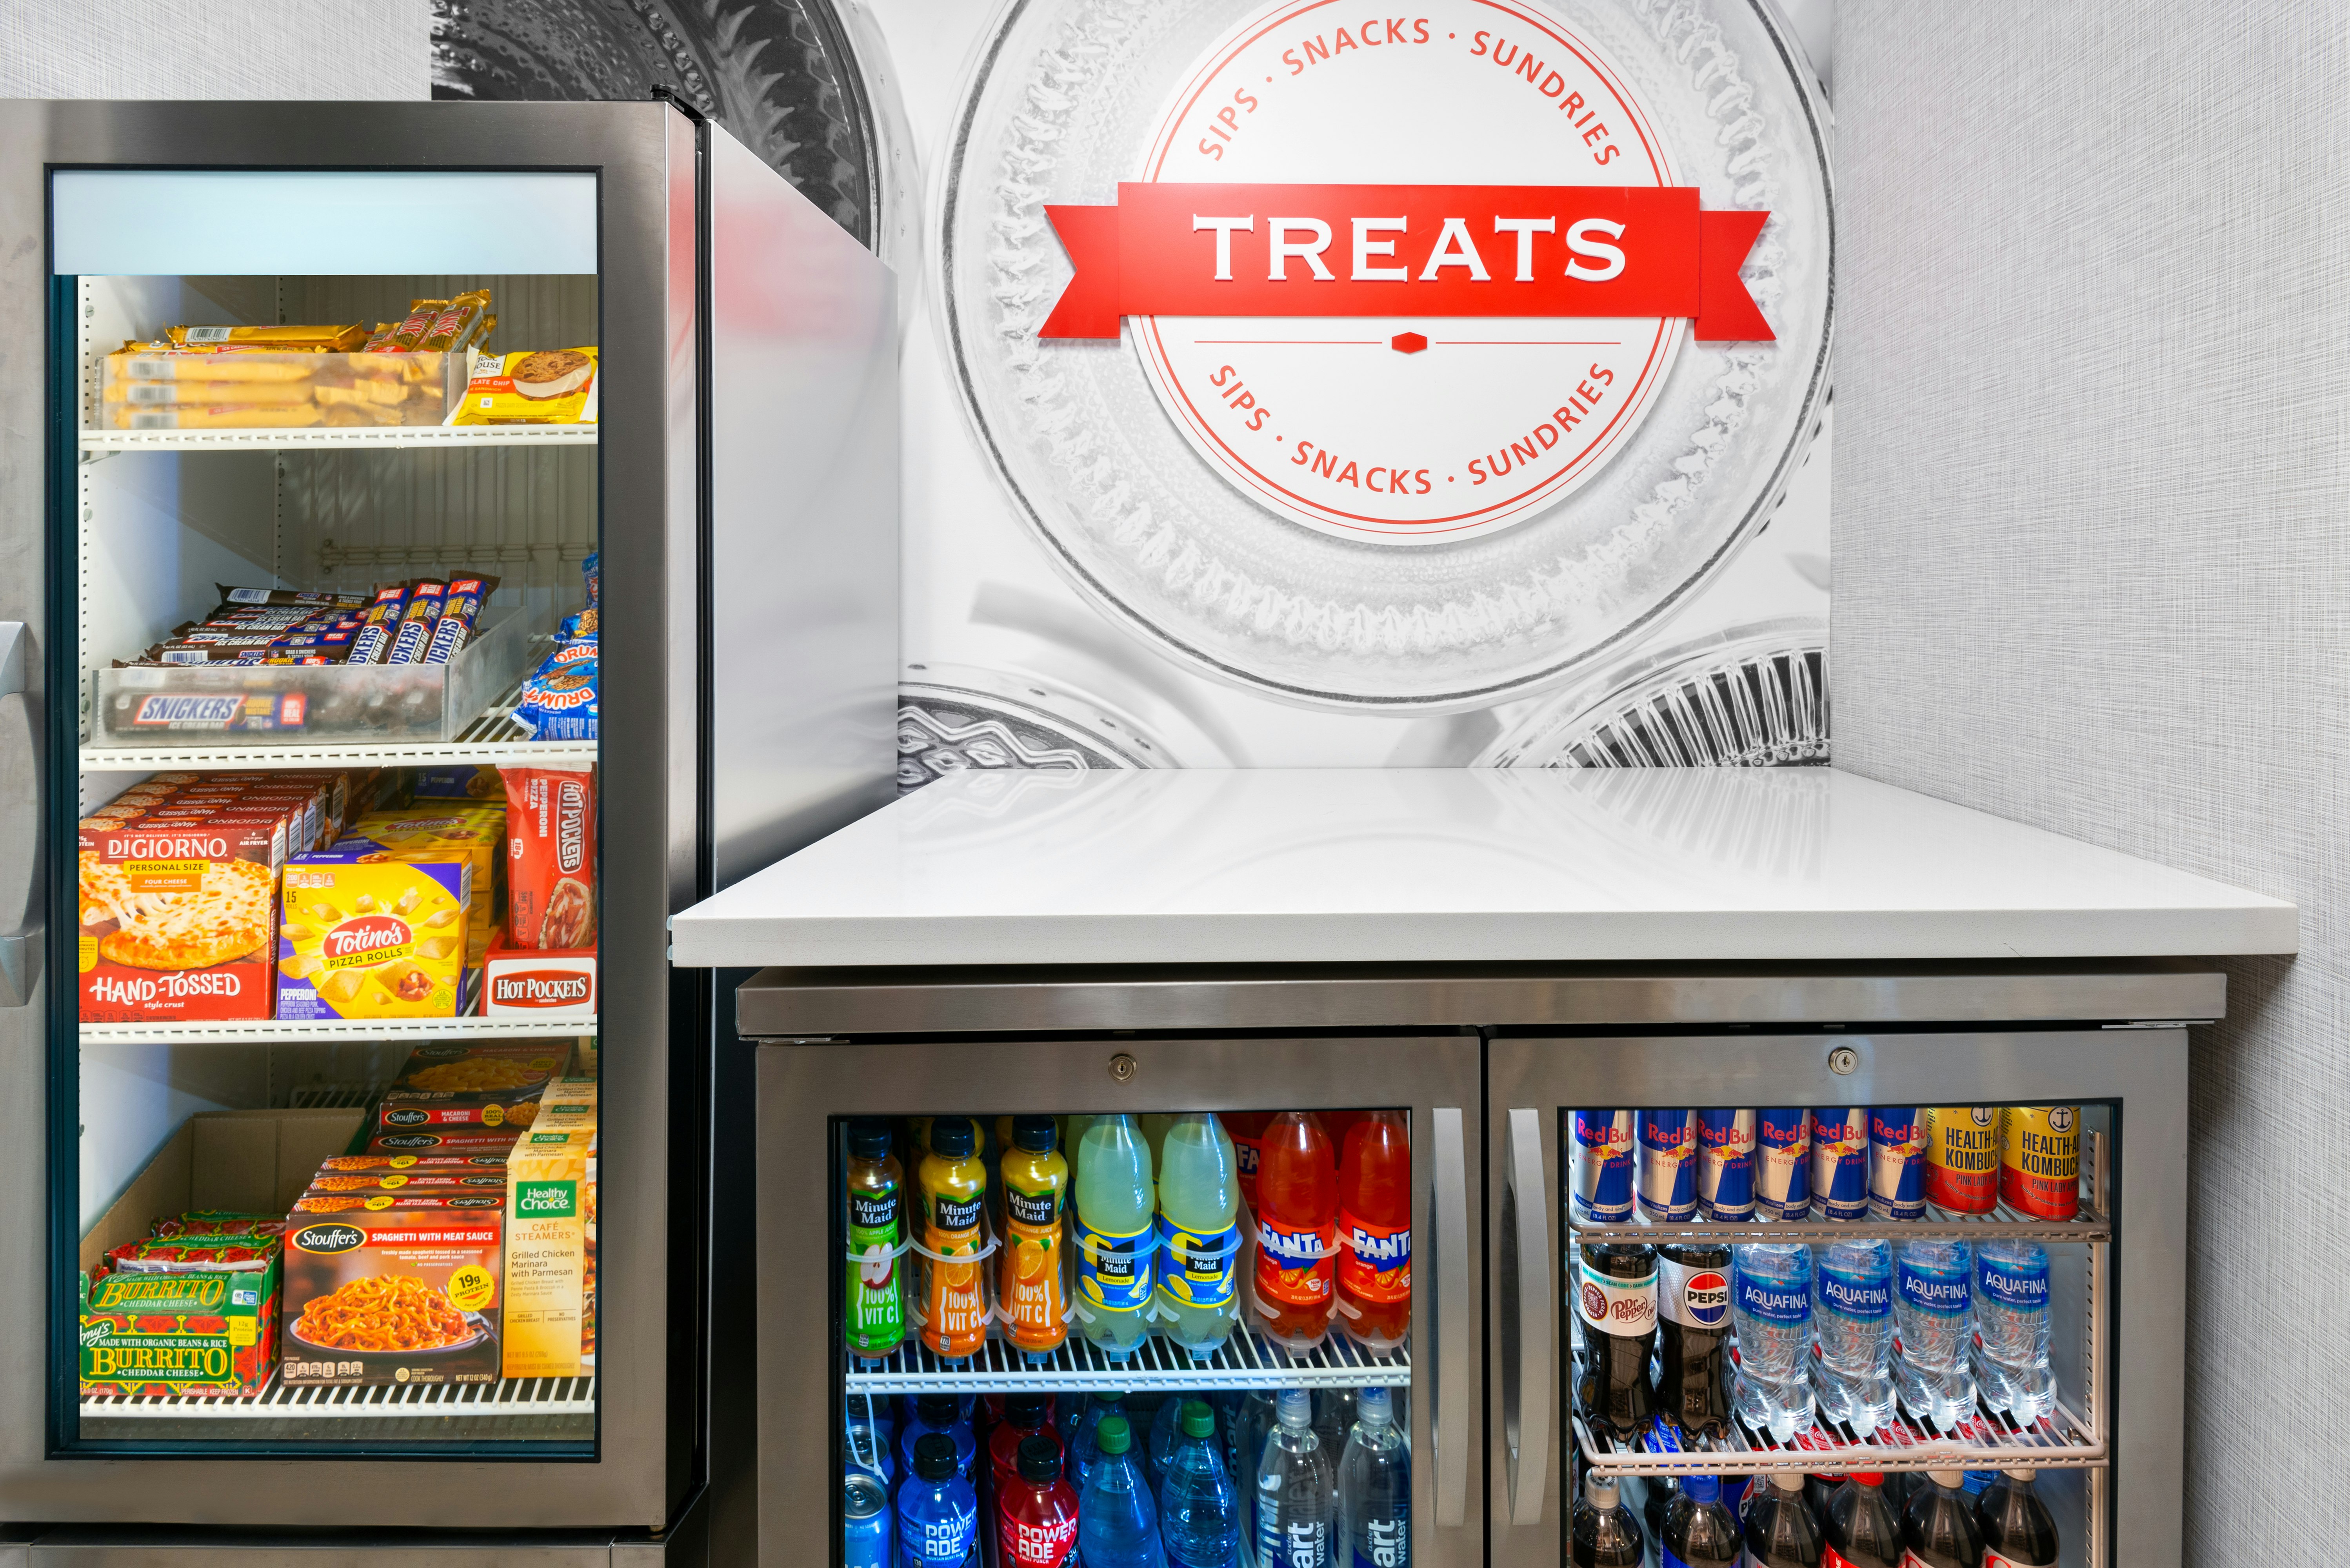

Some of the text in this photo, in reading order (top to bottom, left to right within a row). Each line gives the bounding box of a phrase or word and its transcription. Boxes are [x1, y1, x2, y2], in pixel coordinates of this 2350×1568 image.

[1198, 18, 1620, 166] SIPS SNACKS SUNDRIES
[1193, 214, 1626, 282] TREATS
[430, 307, 470, 337] TWIX
[1209, 363, 1614, 495] SIPS SNACKS SUNDRIES
[142, 698, 238, 720] SNICKERS
[530, 779, 538, 809] PIZZA
[539, 779, 548, 837] PEPPERONI
[561, 784, 583, 868] HOT POCKETS
[286, 891, 296, 903] 15
[330, 922, 403, 955] Totino's
[330, 948, 402, 968] PIZZA ROLLS
[281, 989, 316, 1000] PEPPERONI
[496, 977, 586, 999] HOT POCKETS
[144, 1001, 163, 1009] style
[391, 1112, 424, 1123] Stouffer's
[1578, 1118, 1634, 1143] Red Bull
[1698, 1118, 1754, 1144] Red Bull
[1764, 1120, 1797, 1142] Red
[1811, 1115, 1868, 1141] Red Bull
[1874, 1118, 1907, 1140] Red
[385, 1137, 434, 1145] Stouffer's
[1579, 1152, 1631, 1169] ENERGY DRINK
[1731, 1160, 1752, 1169] DRINK
[1766, 1155, 1798, 1166] ENERGY
[1845, 1156, 1865, 1165] DRINK
[1875, 1152, 1908, 1165] ENERGY
[1956, 1174, 1987, 1187] PINK LADY
[2032, 1178, 2065, 1192] PINK LADY
[527, 1188, 567, 1200] Healthy
[1009, 1192, 1051, 1210] Minute
[521, 1198, 568, 1210] Choice
[856, 1198, 896, 1212] Minute
[940, 1201, 981, 1215] Minute
[1650, 1202, 1668, 1211] Vitalizes
[1765, 1199, 1783, 1210] Vitalizes
[862, 1209, 892, 1224] Maid
[946, 1214, 975, 1227] Maid
[1015, 1207, 1045, 1221] Maid
[532, 1221, 558, 1231] CAFÉ
[301, 1230, 358, 1248] Stouffer's
[372, 1232, 493, 1241] SPAGHETTI WITH MEAT SAUCE
[515, 1232, 571, 1241] STEAMERS
[512, 1251, 539, 1259] Grilled
[1105, 1263, 1127, 1273] Maid
[1194, 1261, 1216, 1270] Maid
[1355, 1261, 1373, 1270] orange
[458, 1274, 480, 1288] 19g
[1906, 1276, 1968, 1299] AQUAFINA
[1985, 1271, 2047, 1294] AQUAFINA
[96, 1280, 224, 1307] BURRITO
[455, 1283, 489, 1298] PROTEIN
[1588, 1285, 1602, 1299] PEPPER
[1687, 1292, 1728, 1304] PEPSI
[1745, 1286, 1808, 1310] AQUAFINA
[1826, 1281, 1888, 1304] AQUAFINA
[1610, 1301, 1645, 1321] Pepper
[1625, 1299, 1638, 1309] Dr
[865, 1307, 894, 1325] VIT C
[948, 1312, 967, 1330] VIT
[1034, 1305, 1042, 1322] C
[89, 1348, 228, 1376] BURRITO
[1019, 1518, 1076, 1543] POWER
[926, 1537, 960, 1556] ADE
[1019, 1539, 1054, 1559] ADE
[1315, 1522, 1324, 1566] water
